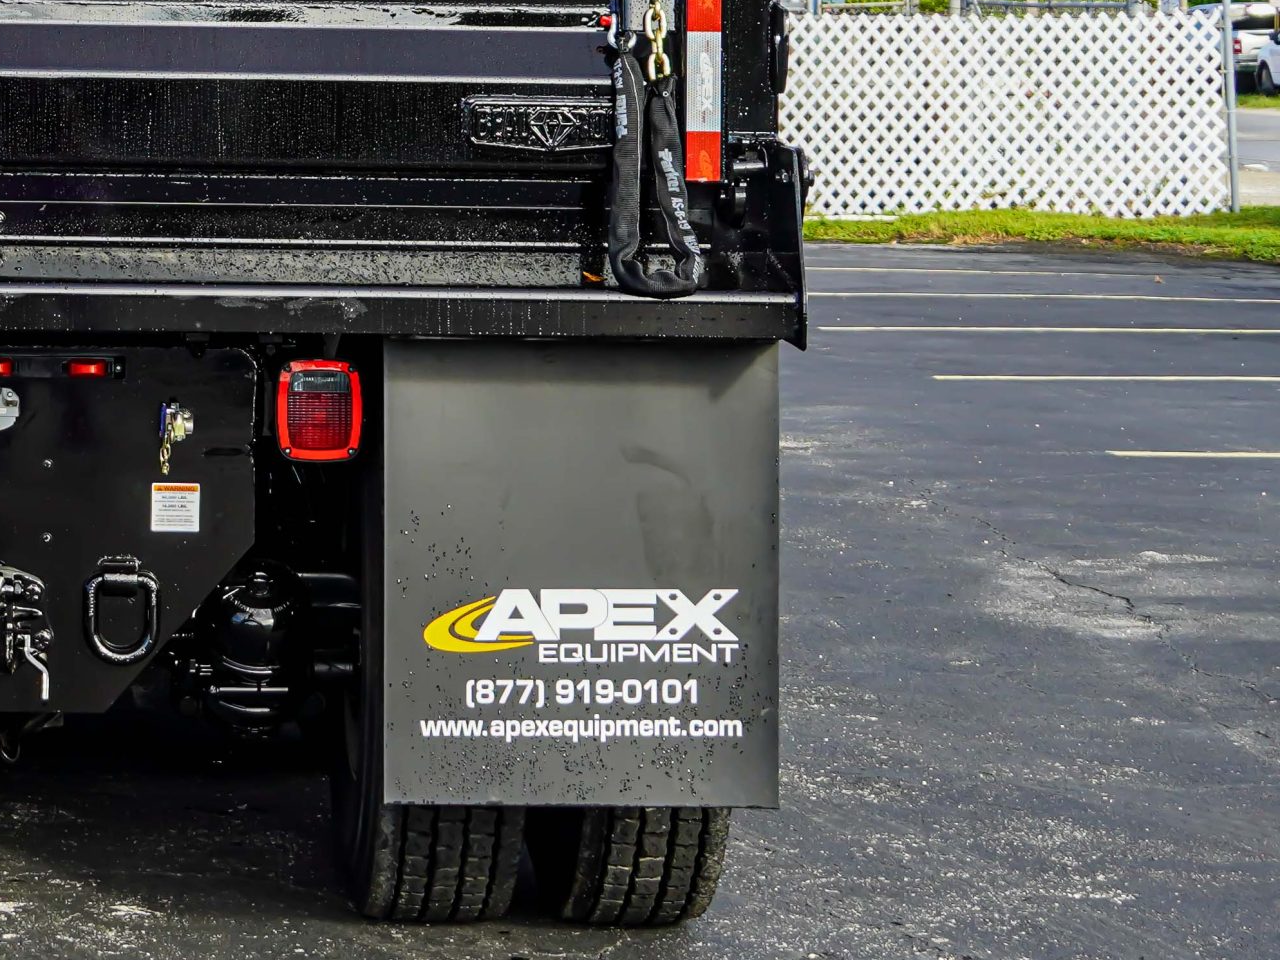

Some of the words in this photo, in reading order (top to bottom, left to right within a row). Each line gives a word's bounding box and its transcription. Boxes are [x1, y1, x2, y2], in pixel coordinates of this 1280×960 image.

[474, 588, 739, 641] APEX
[538, 643, 739, 663] EQUIPMENT
[465, 678, 545, 708] (877)
[555, 678, 698, 704] 919-0101
[420, 713, 743, 743] www.apexequipment.com
